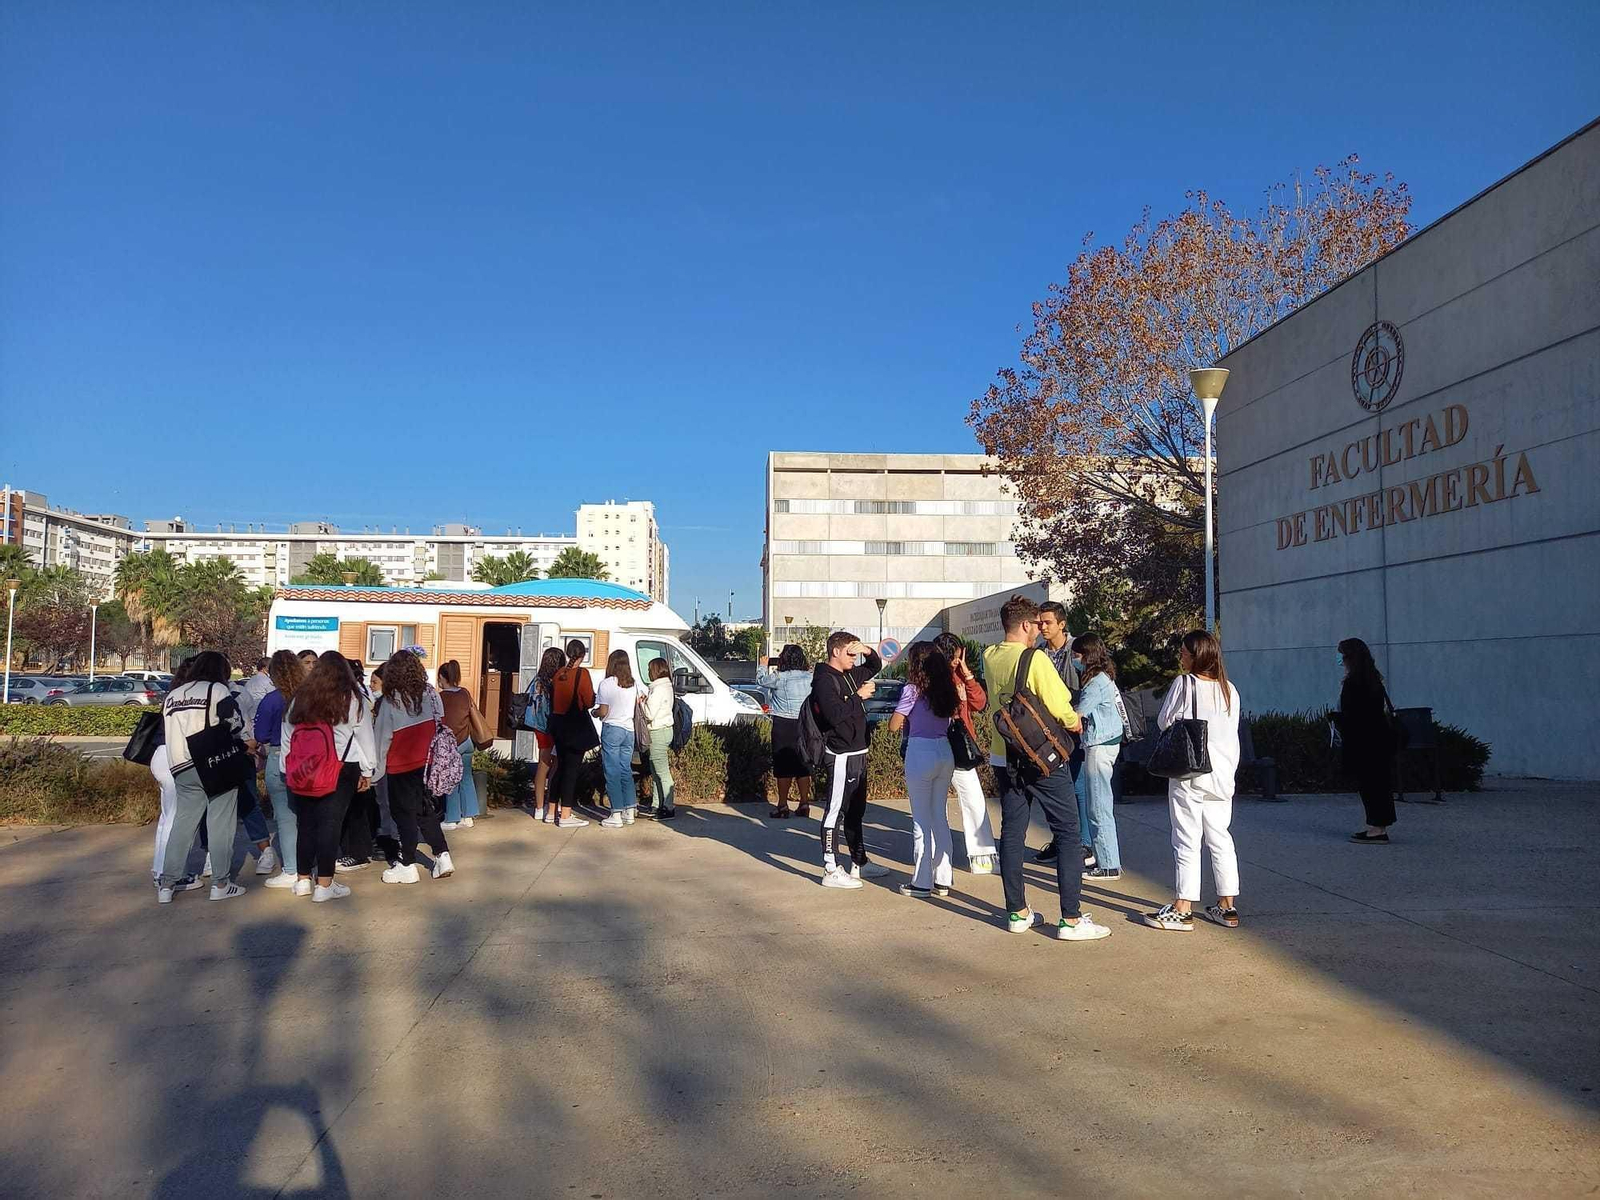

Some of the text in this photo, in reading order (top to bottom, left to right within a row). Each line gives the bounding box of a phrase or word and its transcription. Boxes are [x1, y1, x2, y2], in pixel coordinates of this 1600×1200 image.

[1308, 403, 1470, 490] FACULTAD
[1275, 443, 1542, 551] DE ENFERMERÍA
